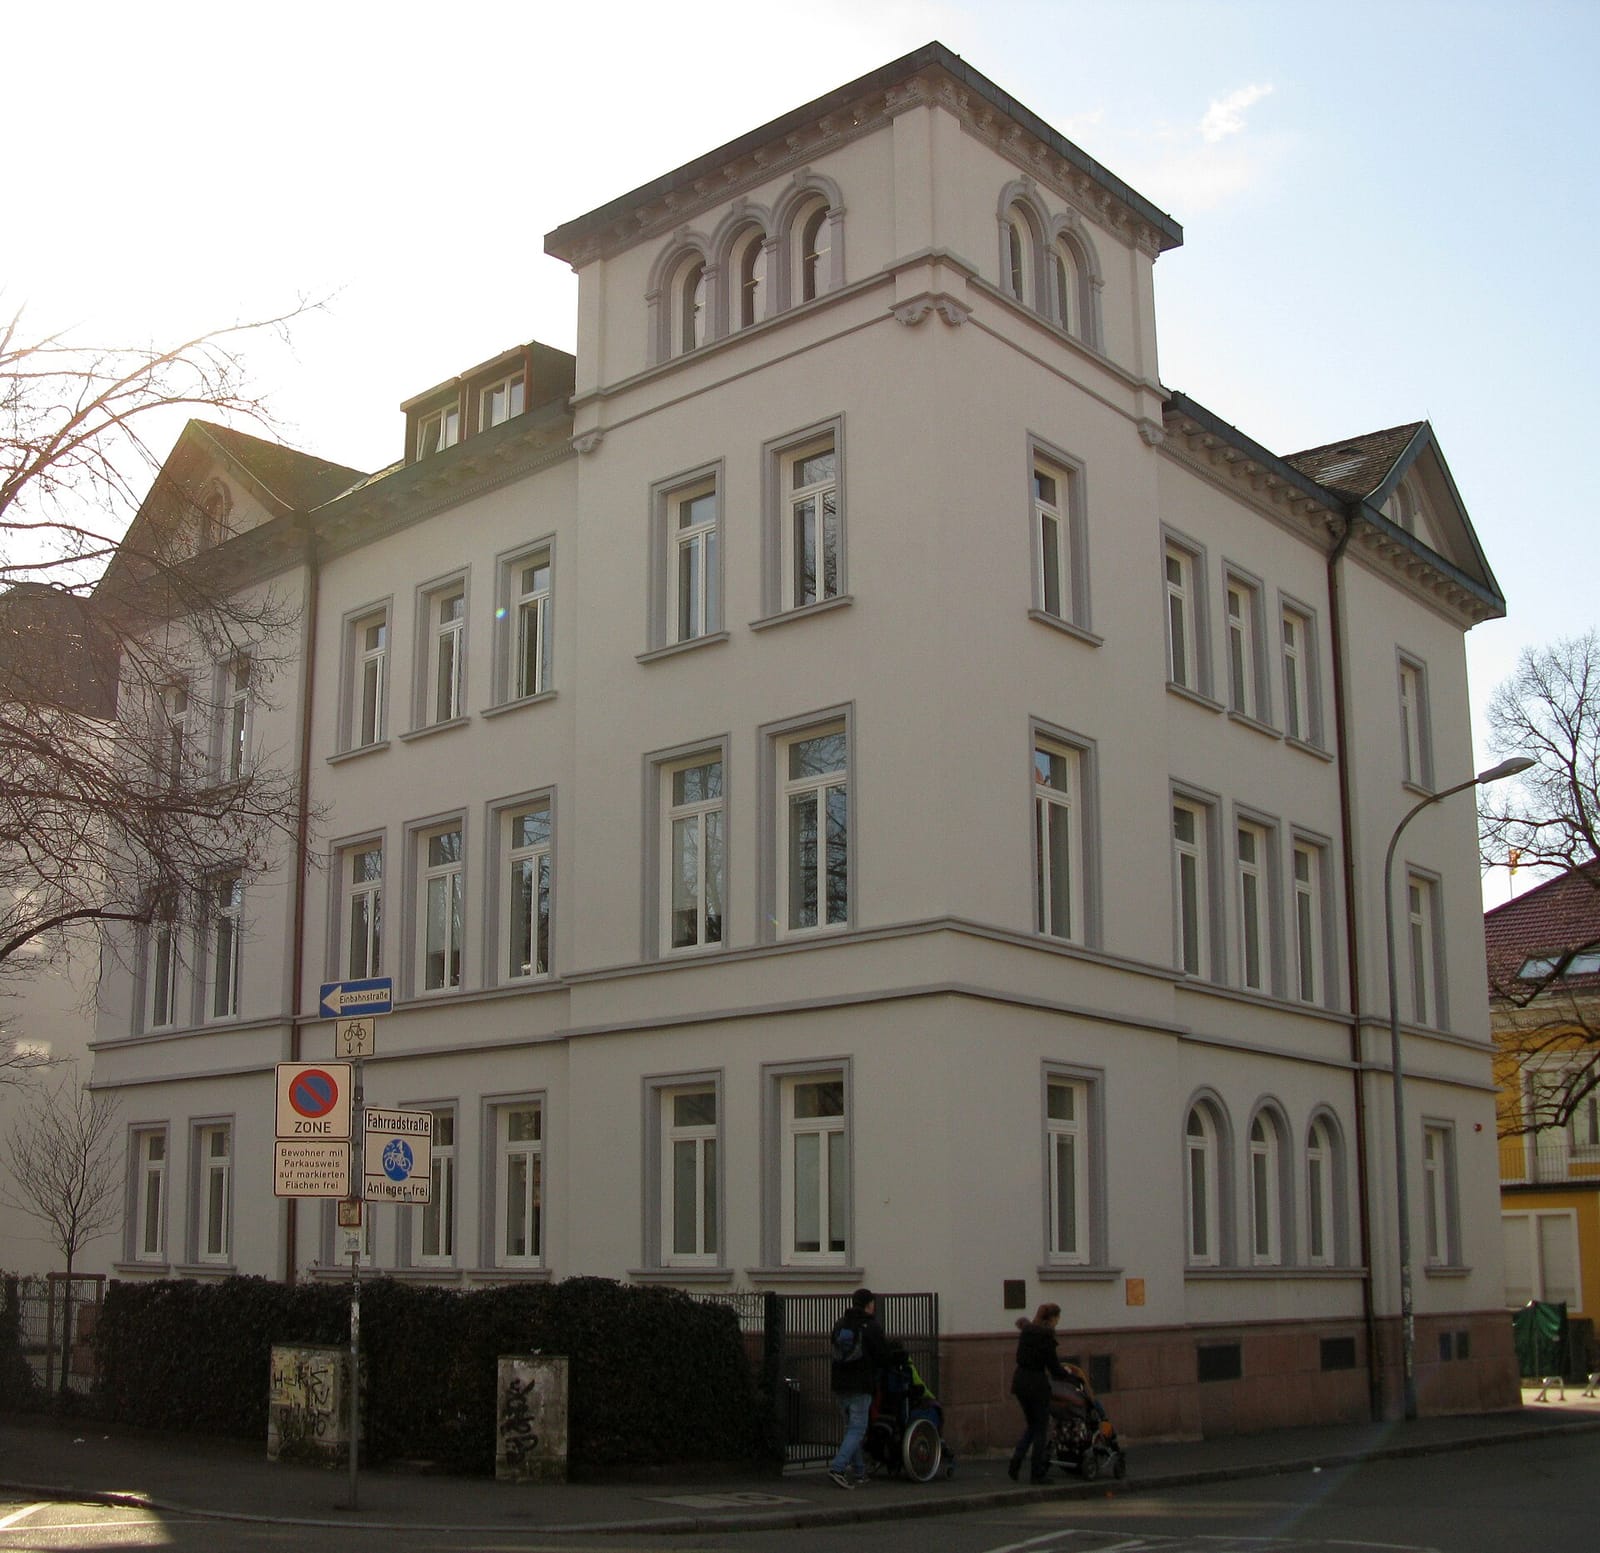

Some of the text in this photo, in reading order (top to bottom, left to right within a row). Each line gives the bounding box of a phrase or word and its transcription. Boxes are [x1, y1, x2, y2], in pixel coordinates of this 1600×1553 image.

[340, 991, 388, 1003] Einbahnstraße
[294, 1121, 332, 1134] ZONE
[367, 1113, 429, 1132] Fahrradstraße
[281, 1148, 343, 1157] Bewohner mit
[284, 1159, 340, 1168] Parkausweis
[279, 1170, 345, 1178] auf markierten
[285, 1180, 339, 1189] Flächen frei
[367, 1182, 428, 1198] Anlieger frei
